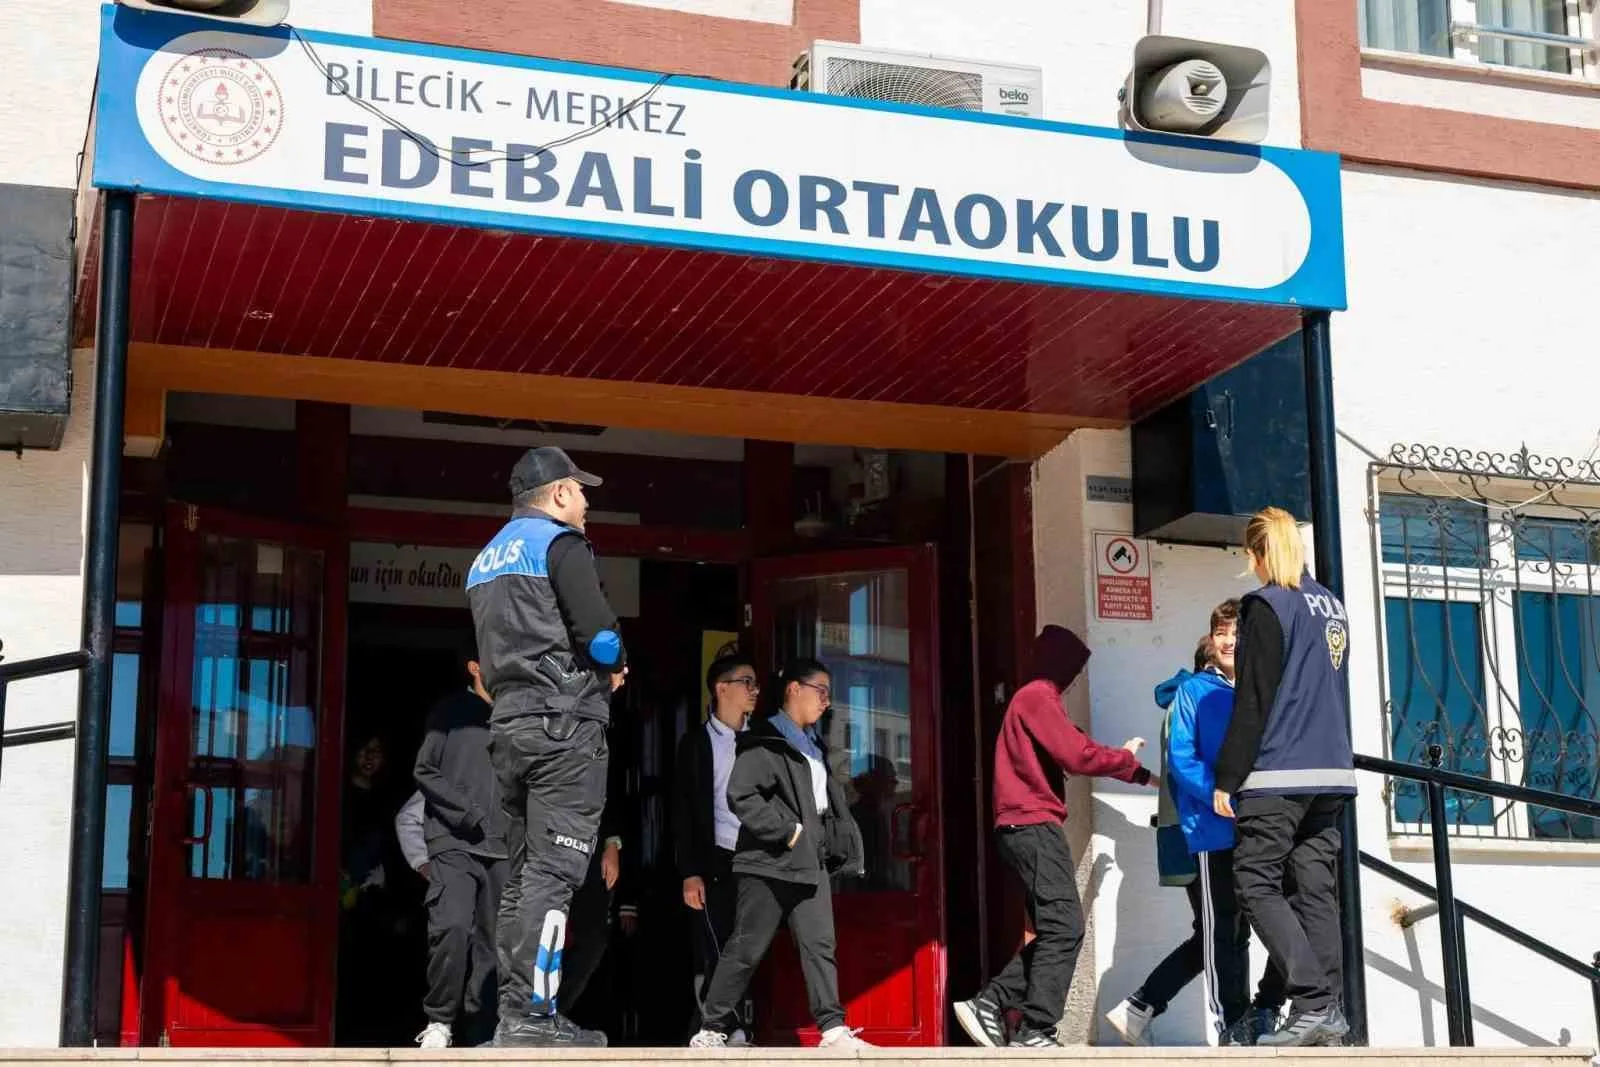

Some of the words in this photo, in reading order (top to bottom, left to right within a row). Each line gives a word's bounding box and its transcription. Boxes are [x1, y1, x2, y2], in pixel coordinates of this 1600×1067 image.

[326, 59, 485, 113] BİLECİK
[525, 87, 687, 136] MERKEZ
[999, 88, 1029, 102] beko
[323, 120, 702, 219] EDEBALİ
[733, 169, 1220, 273] ORTAOKULU
